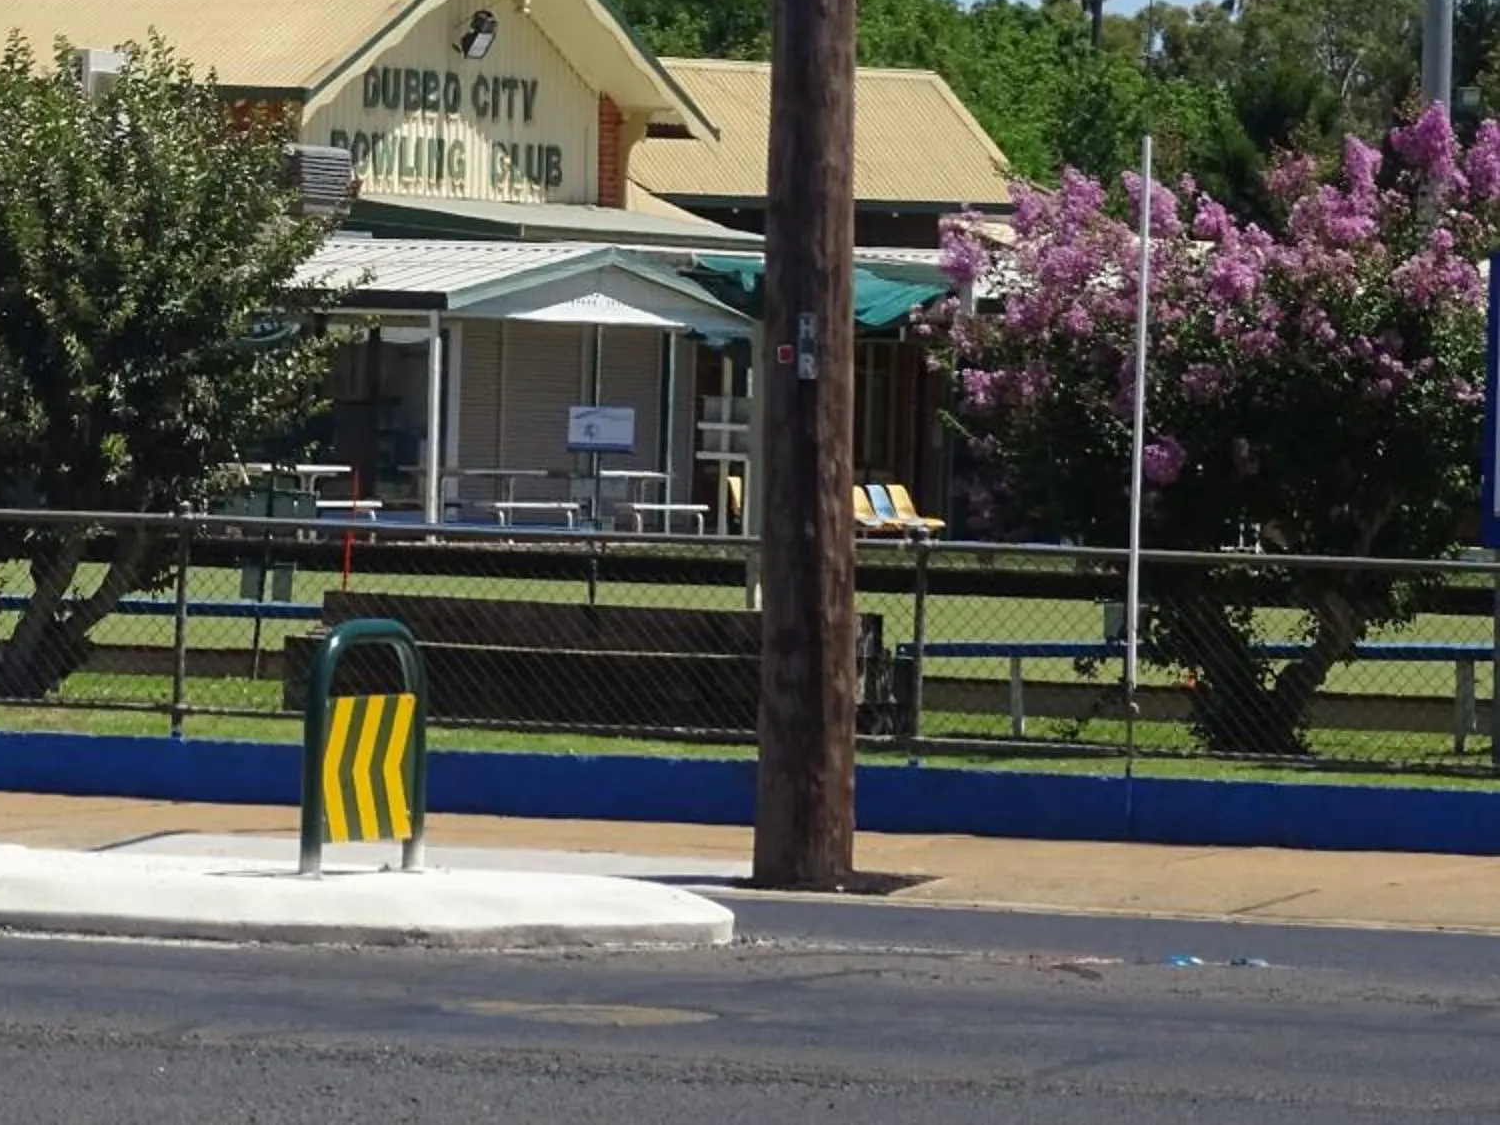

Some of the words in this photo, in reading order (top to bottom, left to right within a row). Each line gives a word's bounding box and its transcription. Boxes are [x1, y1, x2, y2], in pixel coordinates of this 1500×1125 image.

[363, 66, 462, 113] DUBBO
[471, 73, 539, 122] CITY
[491, 139, 563, 188] CLUB
